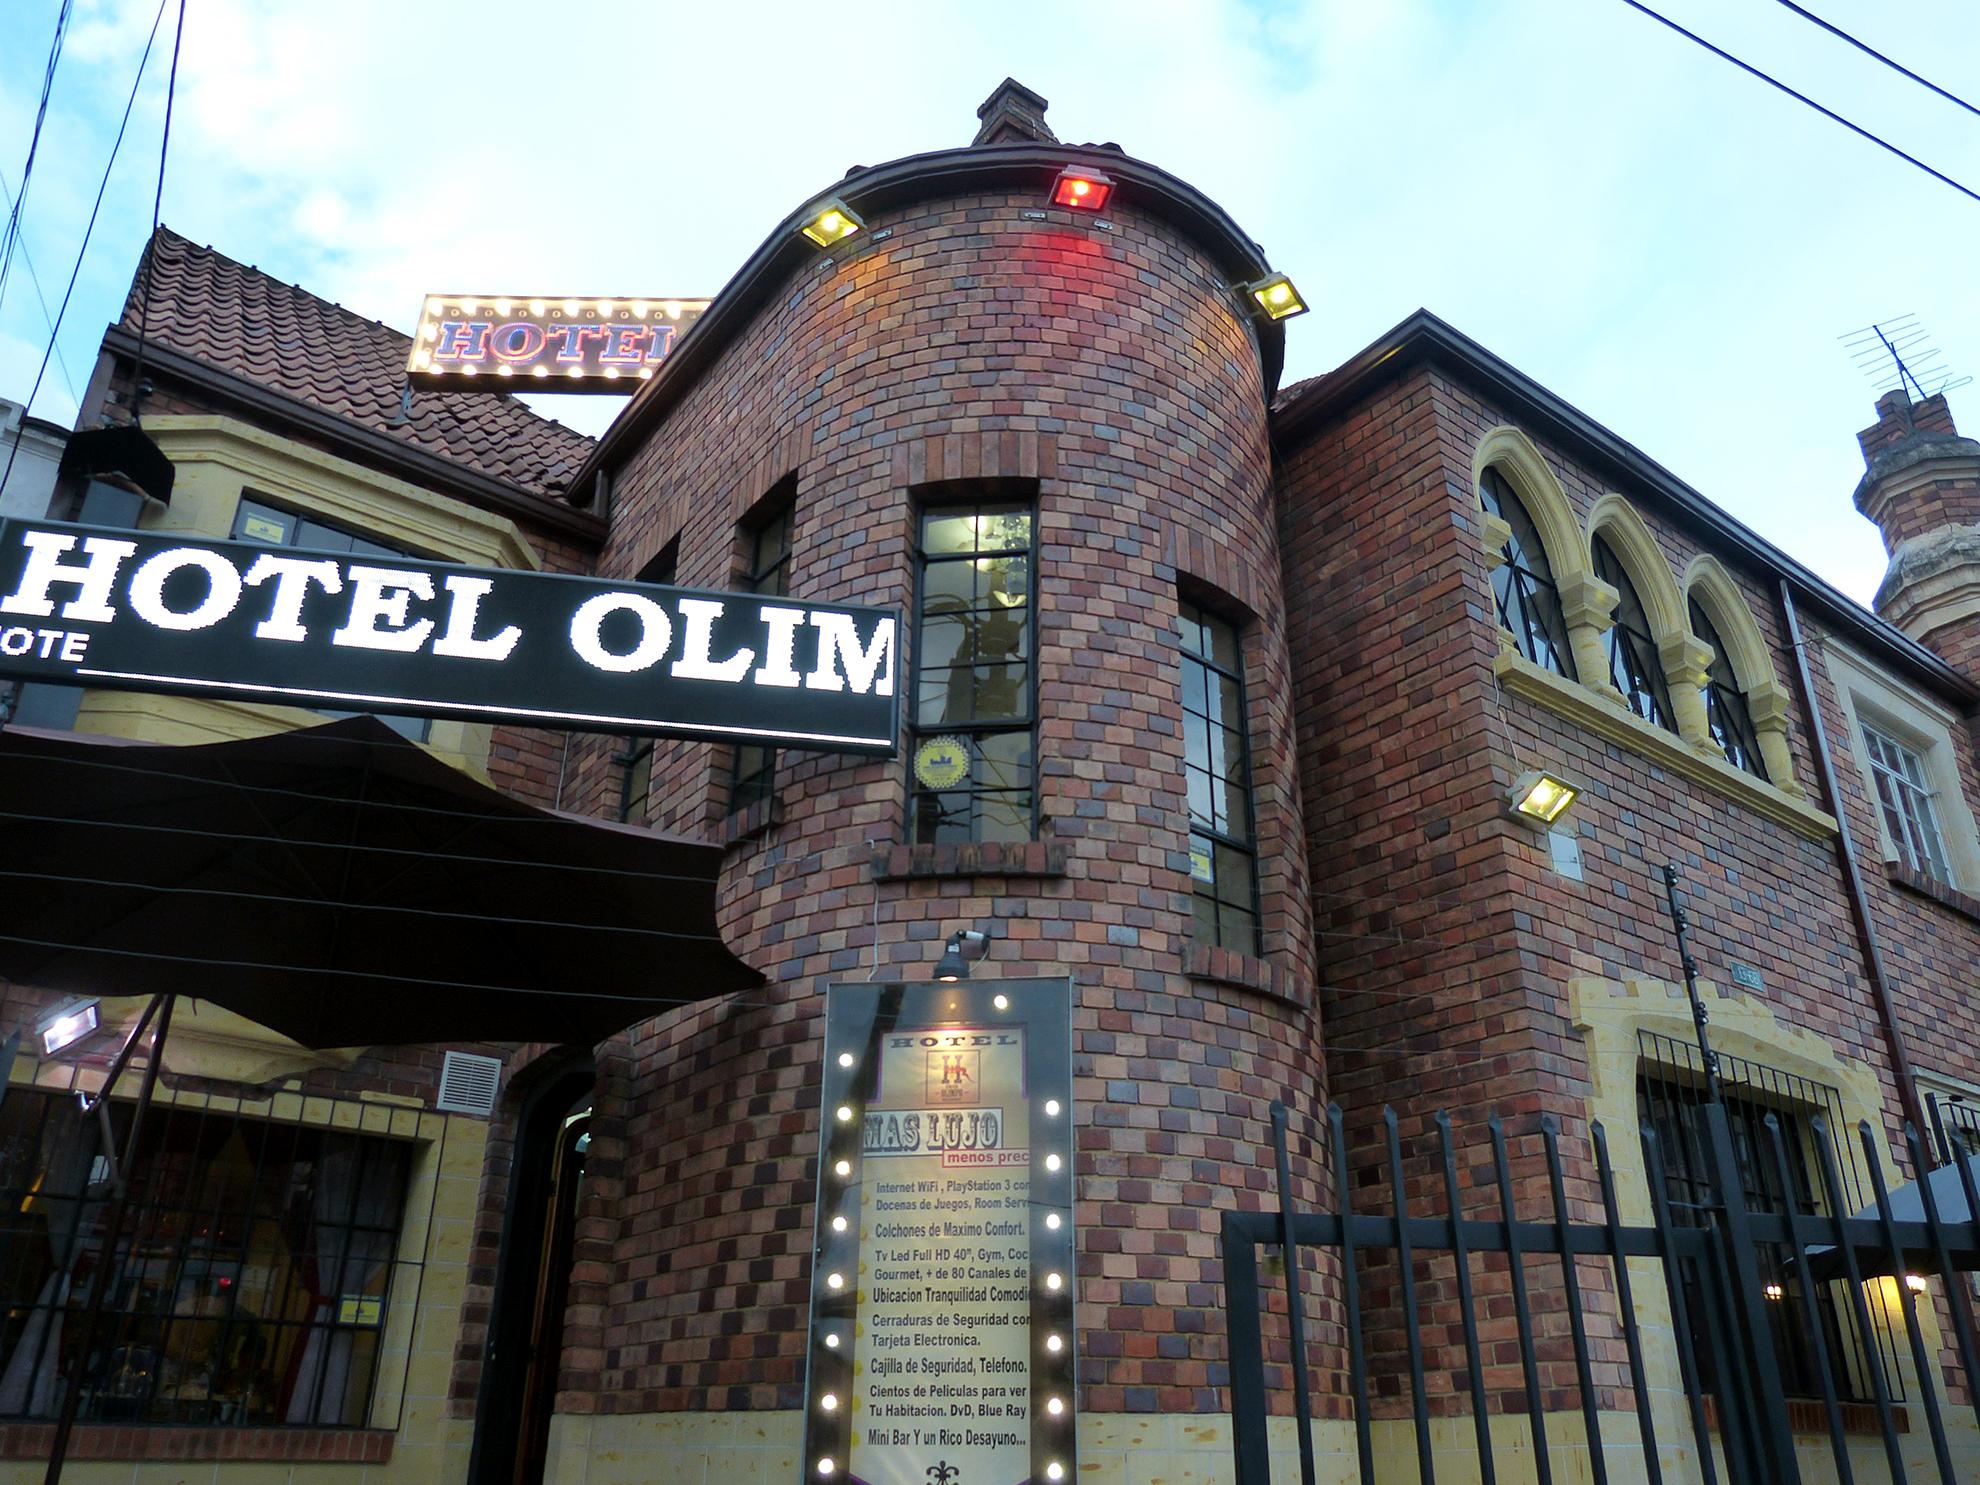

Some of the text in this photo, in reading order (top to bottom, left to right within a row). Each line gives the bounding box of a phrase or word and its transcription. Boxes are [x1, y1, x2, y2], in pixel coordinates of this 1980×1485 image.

[3, 531, 896, 696] HOTEL OLIM
[0, 625, 91, 662] OTE
[890, 1034, 1018, 1049] HOTEL
[863, 1111, 998, 1152] MAS LUJO
[947, 1150, 1030, 1167] menos prec
[876, 1182, 915, 1193] Internet
[917, 1181, 939, 1192] WiFi
[946, 1179, 1002, 1194] PlayStation
[1004, 1179, 1011, 1191] 3
[876, 1196, 1030, 1212] Docenas de Juegos, Room Serv
[875, 1220, 1025, 1238] Colchones de Maximo Confort.
[875, 1250, 888, 1261] Tv
[891, 1250, 910, 1262] Led
[913, 1249, 932, 1261] Full
[935, 1249, 951, 1261] HD
[978, 1248, 1005, 1263] Gym,
[874, 1268, 923, 1281] Gourmet,
[935, 1267, 949, 1279] de
[952, 1267, 965, 1279] 80
[968, 1267, 1011, 1279] Canales
[1014, 1266, 1027, 1279] de
[873, 1287, 922, 1303] Ubicacion
[925, 1286, 987, 1306] Tranquilidad
[872, 1314, 933, 1327] Cerraduras
[936, 1313, 950, 1325] de
[953, 1313, 1009, 1329] Seguridad
[872, 1333, 981, 1350] Tarjeta Electronica.
[870, 1357, 1028, 1377] Cajilla de Seguridad, Telefono.
[870, 1384, 1027, 1399] Cientos de Peliculas para ver
[869, 1404, 1027, 1419] Tu Habitacion. DvD, Blue Ray
[868, 1428, 1026, 1449] Mini Bar Y un Rico Desayuno...
